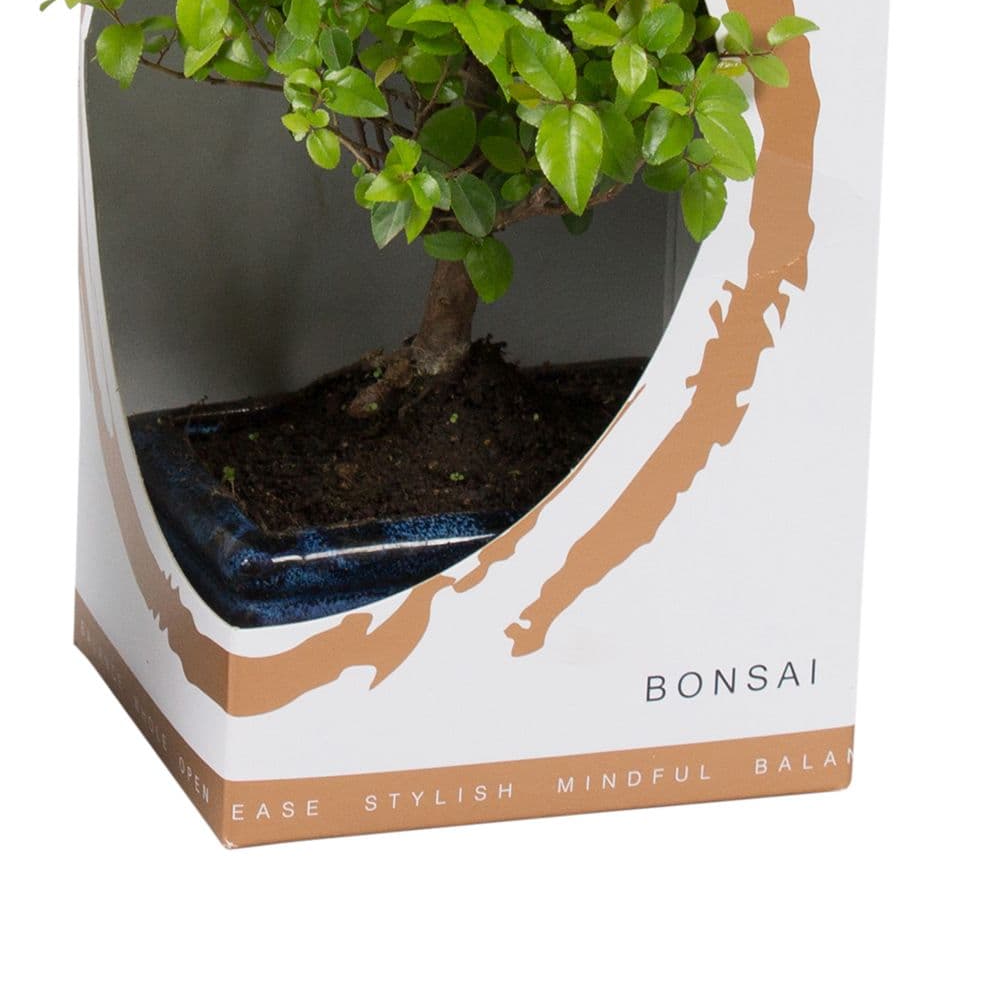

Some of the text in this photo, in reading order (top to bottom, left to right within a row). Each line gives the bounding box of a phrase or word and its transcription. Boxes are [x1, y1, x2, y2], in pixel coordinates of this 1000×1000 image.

[645, 657, 820, 704] BONSAI
[177, 755, 210, 804] OPEN
[231, 799, 321, 822] EASE
[364, 783, 515, 812] STYLISH
[557, 764, 713, 794] MINDFUL
